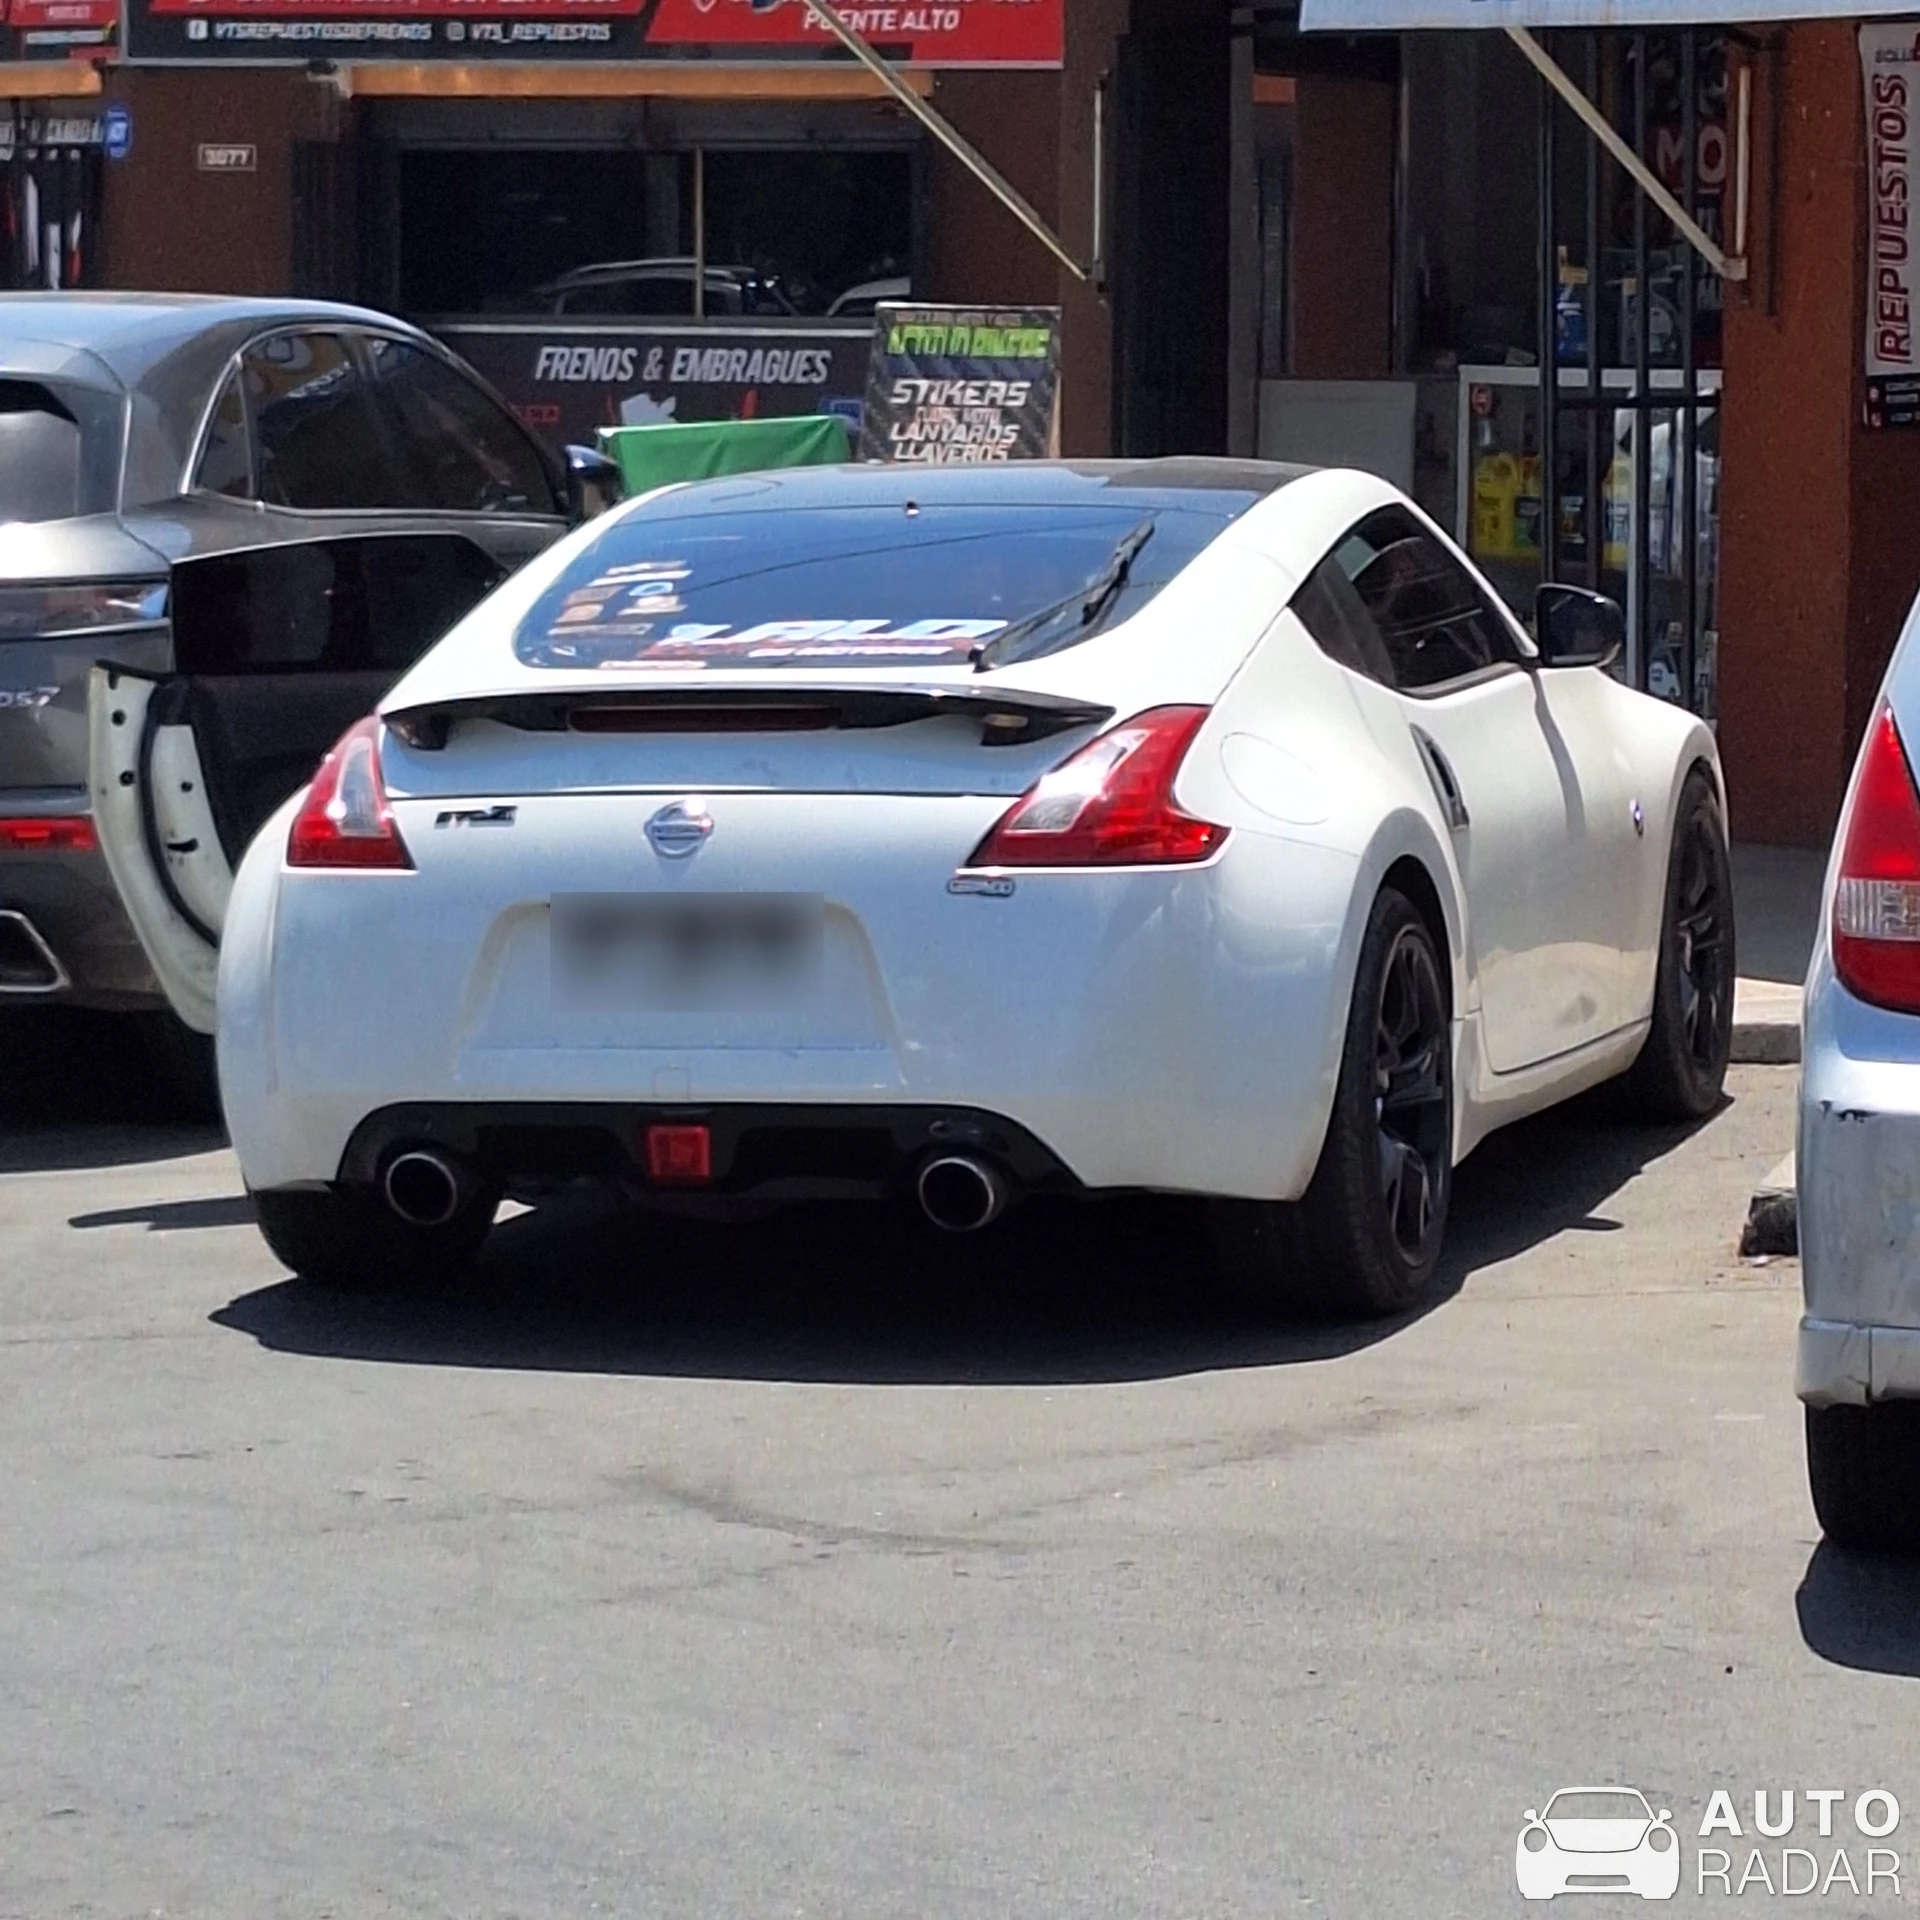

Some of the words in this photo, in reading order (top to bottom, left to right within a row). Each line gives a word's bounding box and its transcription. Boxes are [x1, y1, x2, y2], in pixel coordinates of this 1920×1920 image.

[901, 9, 960, 31] ALTO
[1873, 73, 1912, 364] REPUESTOS
[535, 345, 637, 382] FRENOS
[642, 347, 664, 381] &
[669, 348, 832, 385] EMBRAGUES
[889, 380, 1032, 407] STIKERS
